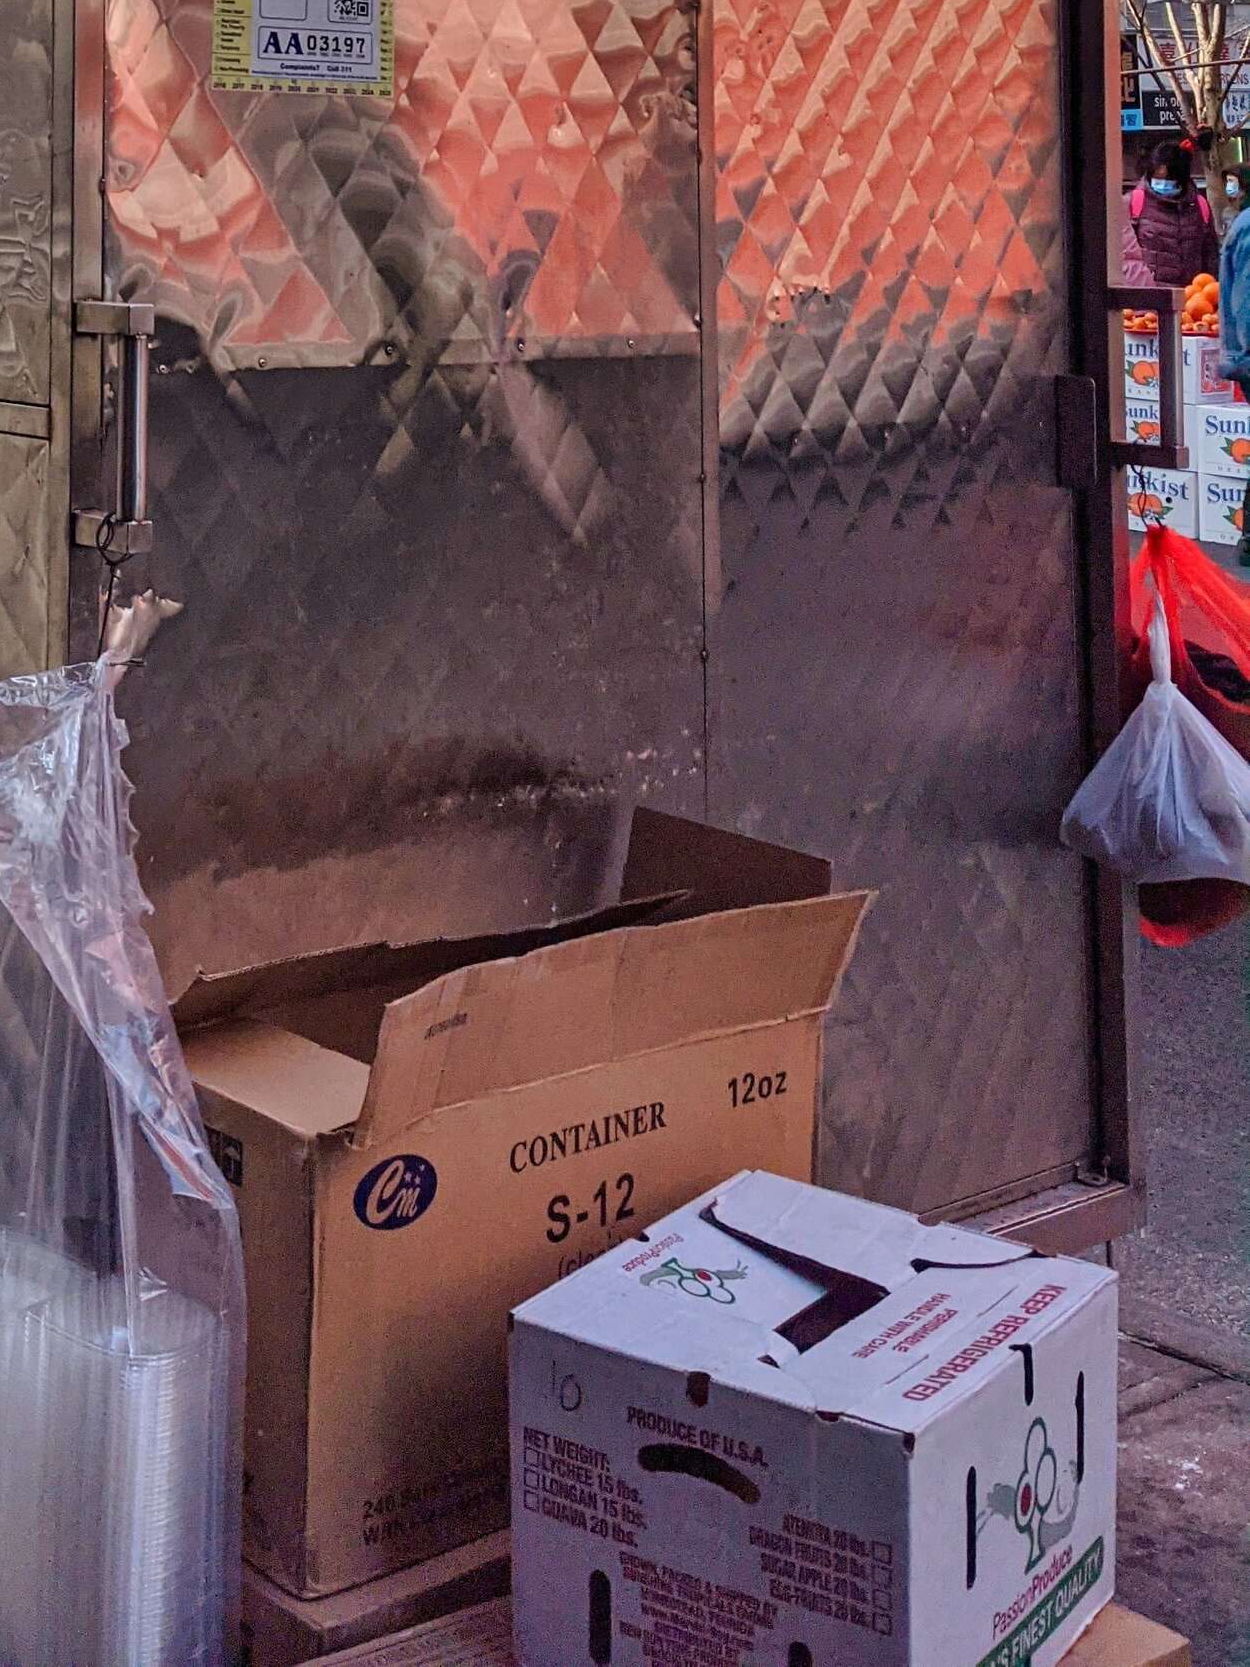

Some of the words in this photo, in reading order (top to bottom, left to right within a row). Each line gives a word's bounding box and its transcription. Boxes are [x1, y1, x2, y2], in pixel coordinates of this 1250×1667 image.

[263, 31, 303, 55] AA
[307, 34, 366, 54] 03197
[280, 63, 320, 71] Complaints?
[727, 1071, 788, 1109] 12oz
[509, 1101, 667, 1174] CONTAINER
[545, 1172, 636, 1244] S-12
[904, 1292, 953, 1322] HANDLE
[1019, 1284, 1068, 1316] KEEP
[851, 1337, 888, 1360] CARE
[879, 1320, 915, 1341] WITH
[892, 1308, 959, 1354] PERISHABLE
[902, 1314, 1031, 1402] REFRIGERATED
[523, 1425, 550, 1451] NET
[552, 1434, 611, 1472] WEIGHT:
[626, 1404, 698, 1445] PRODUCE
[700, 1429, 722, 1450] OF
[722, 1434, 771, 1471] U.S.A.
[541, 1452, 594, 1486] LYCHEE
[599, 1471, 615, 1494] 15
[541, 1475, 598, 1510] LONGAN
[601, 1496, 618, 1518] 15
[541, 1496, 588, 1532] GUAVA
[992, 1544, 1074, 1641] PassionProduce
[1011, 1600, 1054, 1661] FINEST
[1055, 1546, 1102, 1618] QUALITY
